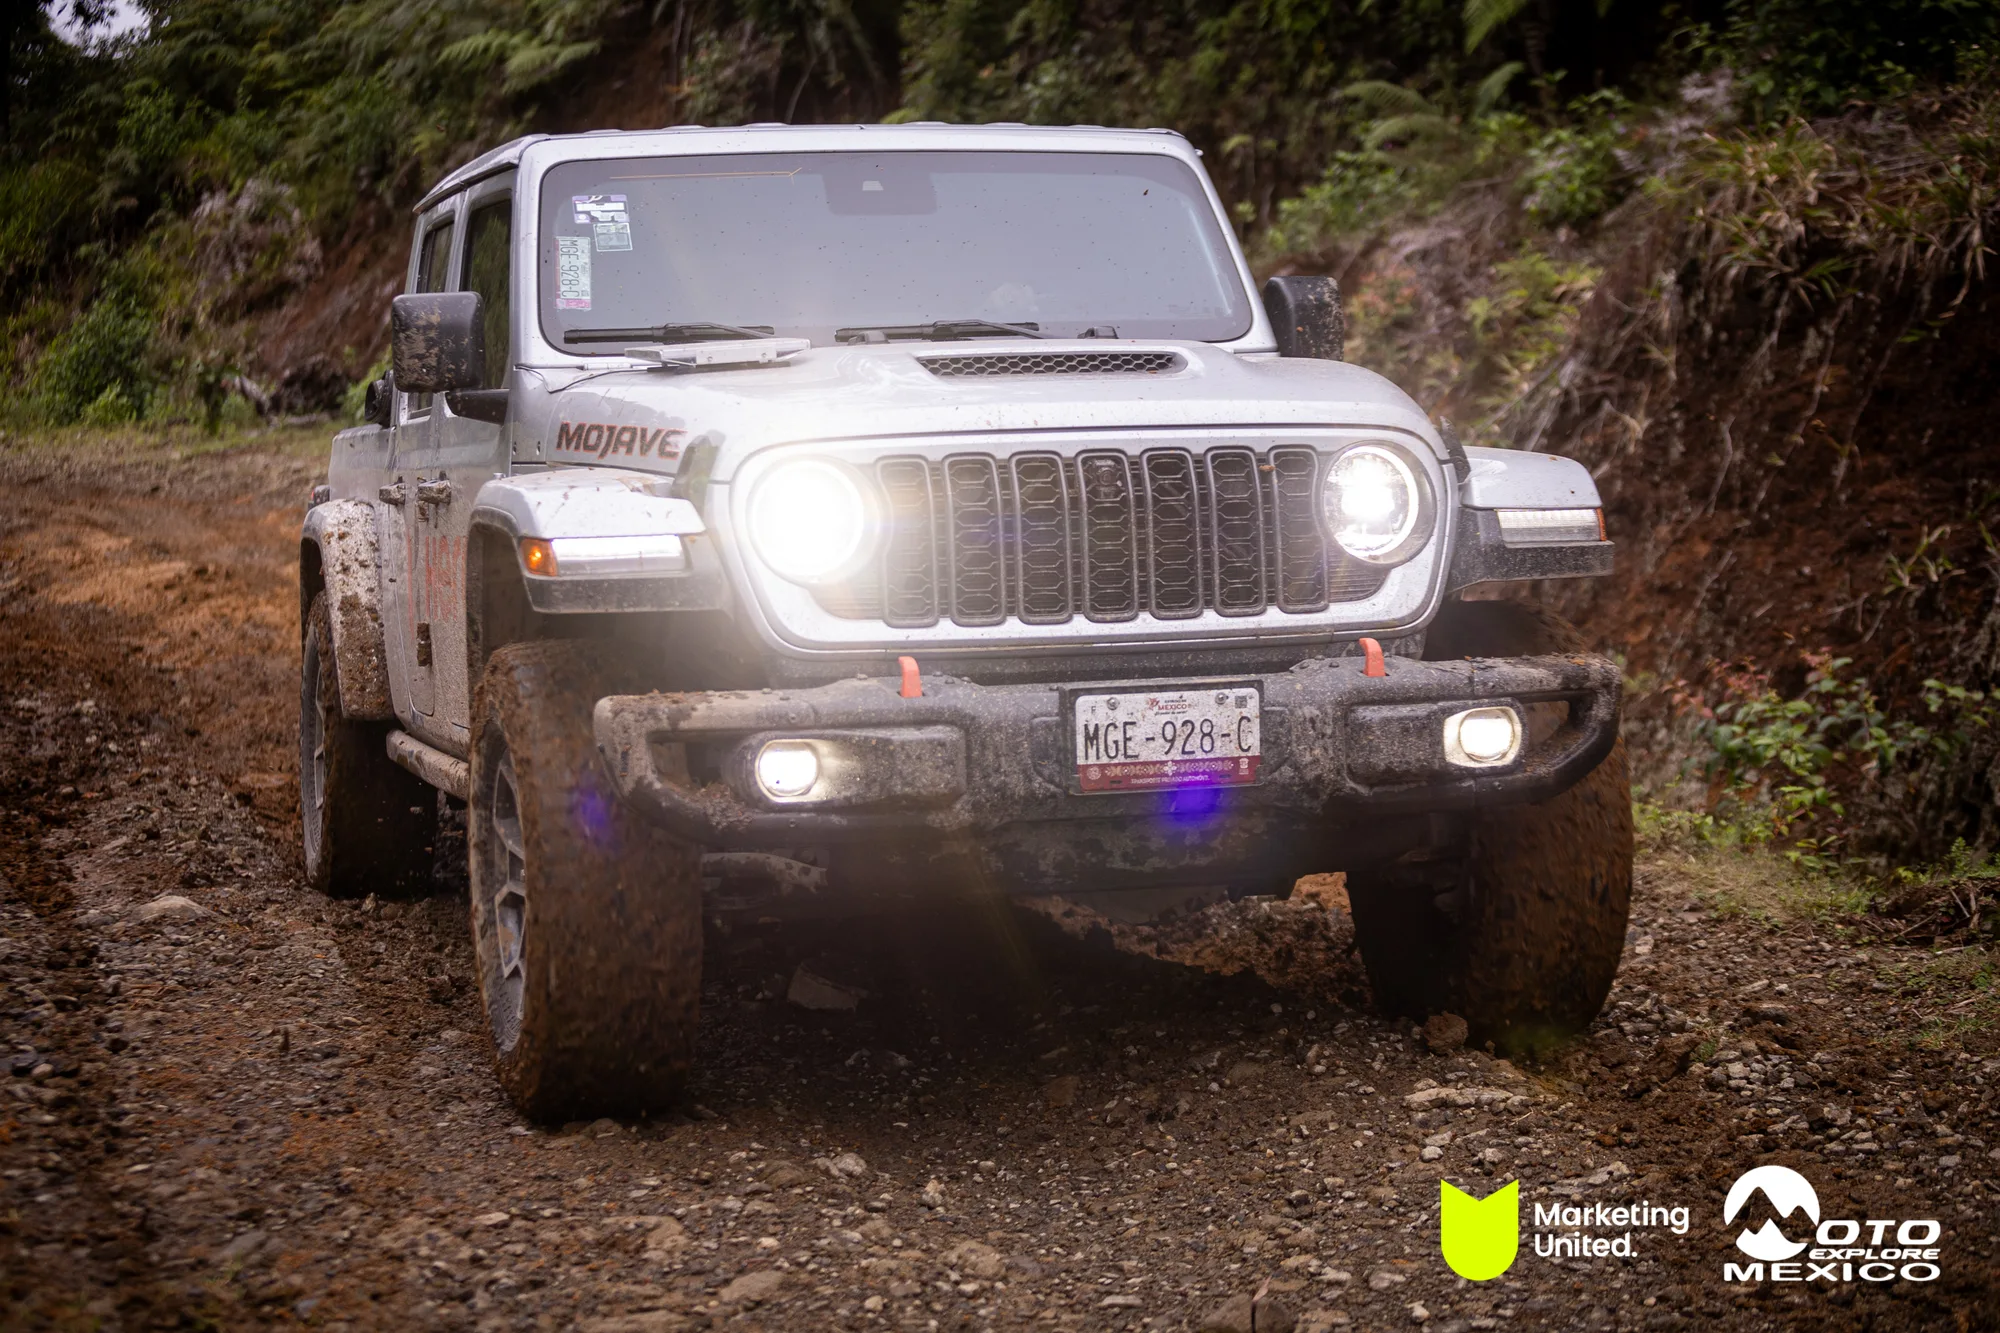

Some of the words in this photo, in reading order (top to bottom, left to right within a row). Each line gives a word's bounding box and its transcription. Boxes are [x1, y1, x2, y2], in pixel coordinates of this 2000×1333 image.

[560, 239, 580, 298] MGE-928-C
[556, 421, 687, 460] MOJAVE
[1084, 716, 1252, 761] MGE-928-C
